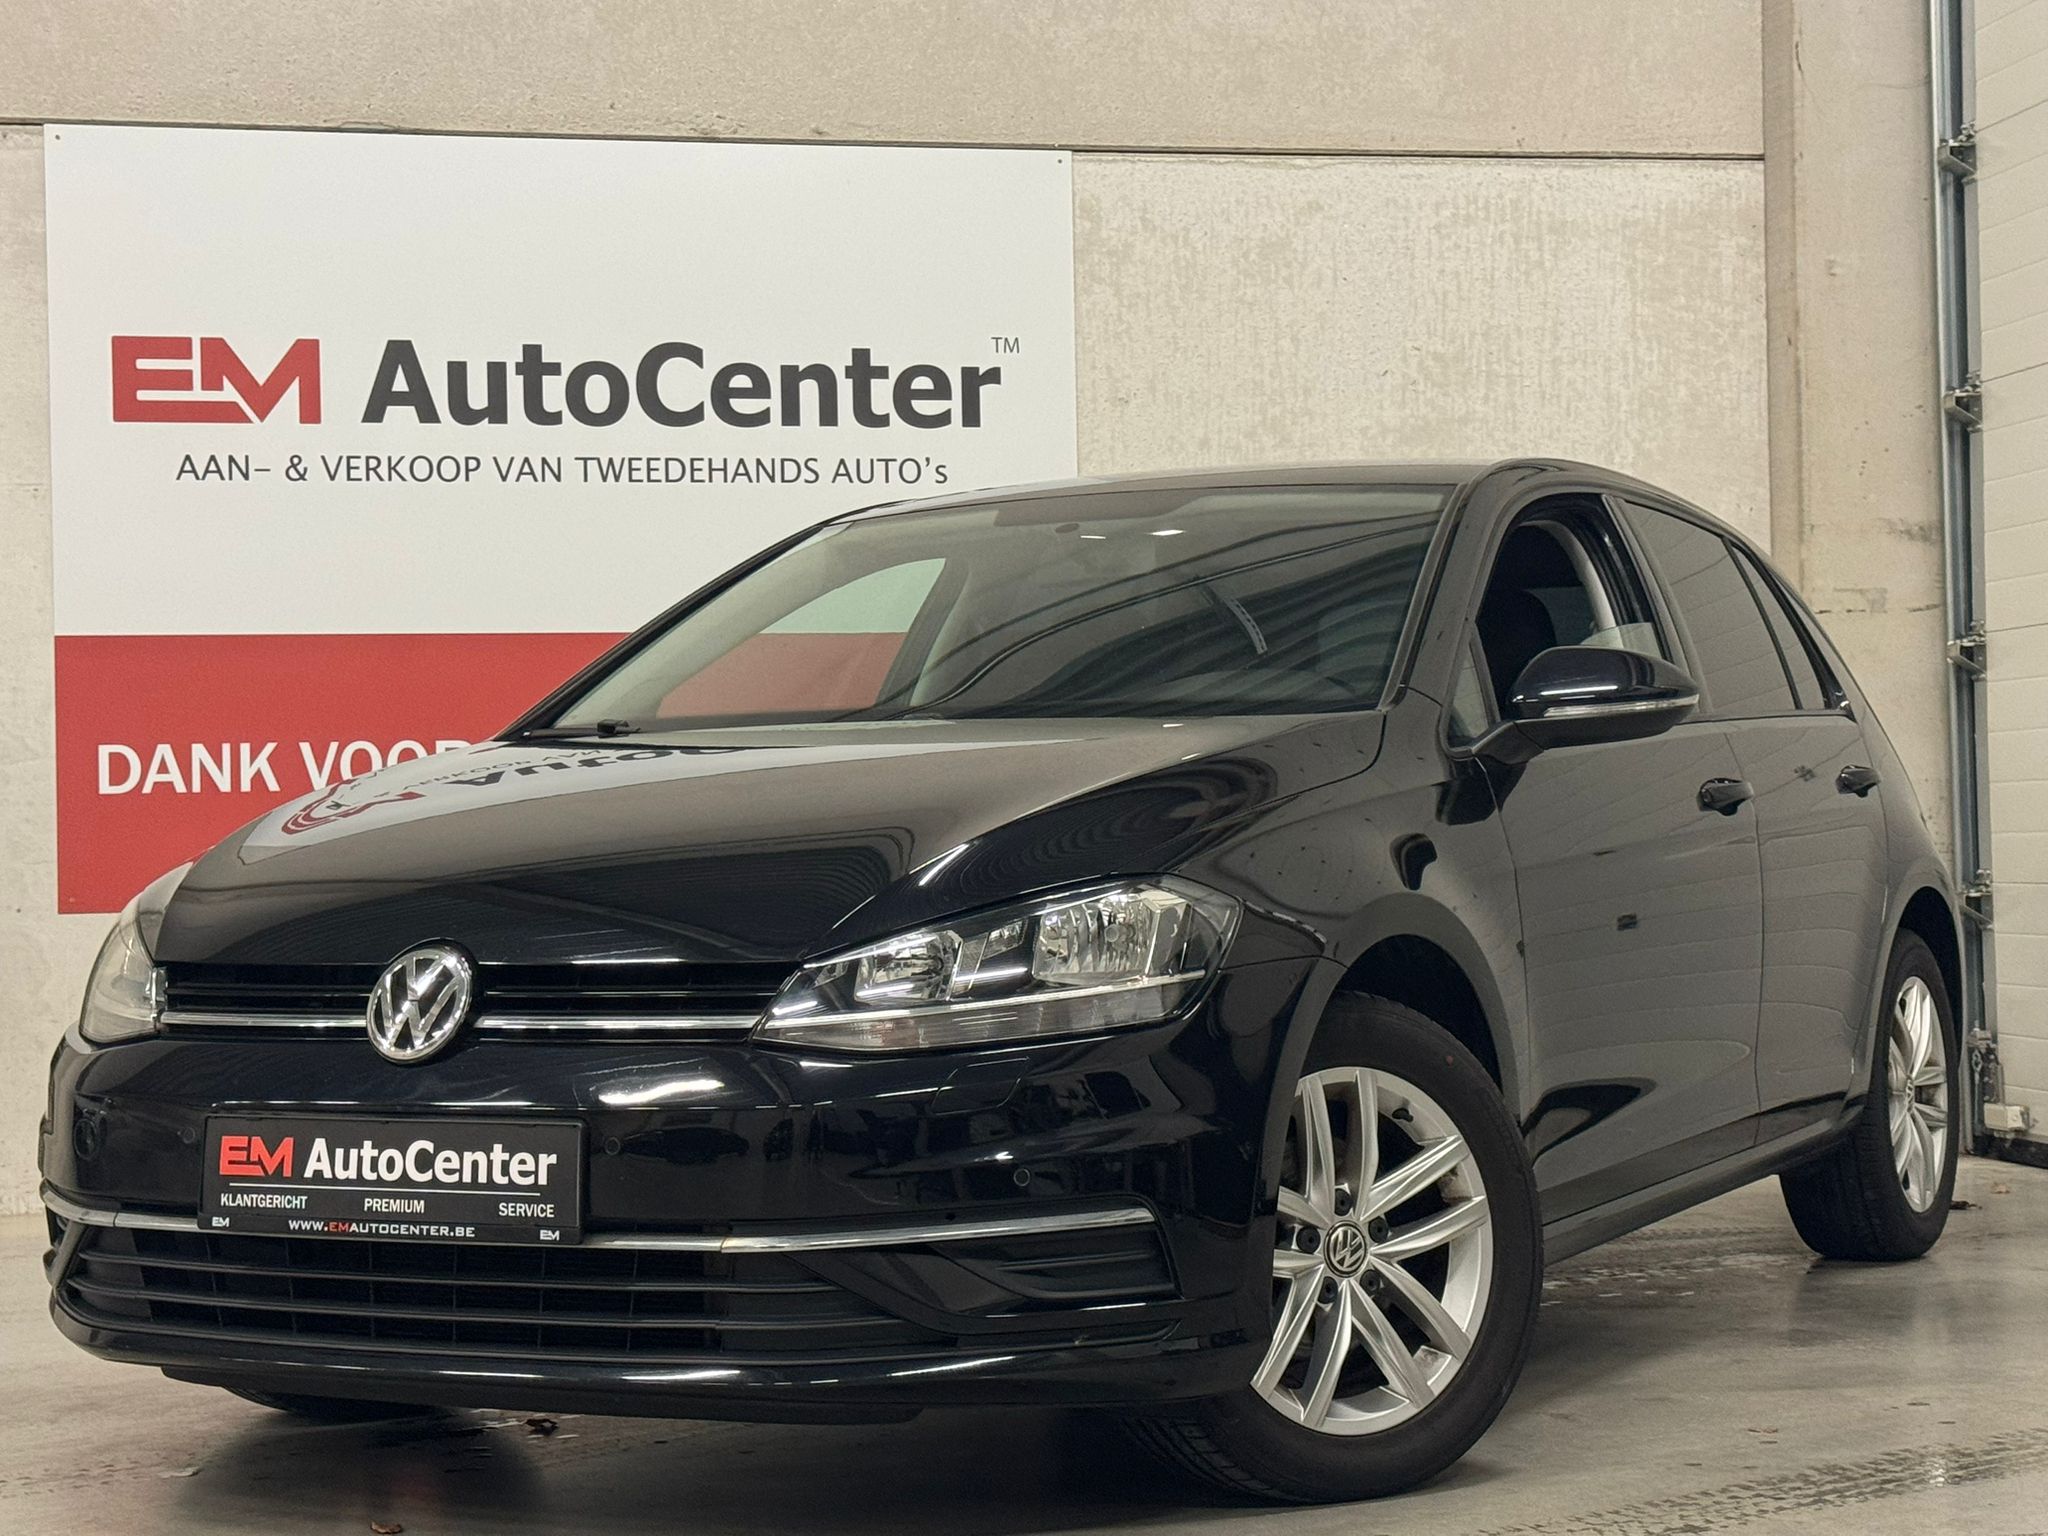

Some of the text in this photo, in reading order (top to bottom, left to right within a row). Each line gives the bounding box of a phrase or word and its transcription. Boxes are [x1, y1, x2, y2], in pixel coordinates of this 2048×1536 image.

[112, 336, 321, 424] EM
[361, 341, 1001, 428] AutoCenter
[285, 455, 308, 482] &
[321, 455, 481, 482] VERKOOP
[493, 456, 562, 482] VAN
[575, 456, 820, 483] TWEEDEHANDS
[832, 456, 948, 484] AUTO's
[98, 742, 281, 794] DANK
[299, 740, 475, 791] VO
[219, 1136, 557, 1186] EM AutoCenter
[220, 1193, 555, 1218] KLANTGERICHT PREMIUM SERVICE
[288, 1220, 475, 1238] WWW.EMAUTOCENTER.BE
